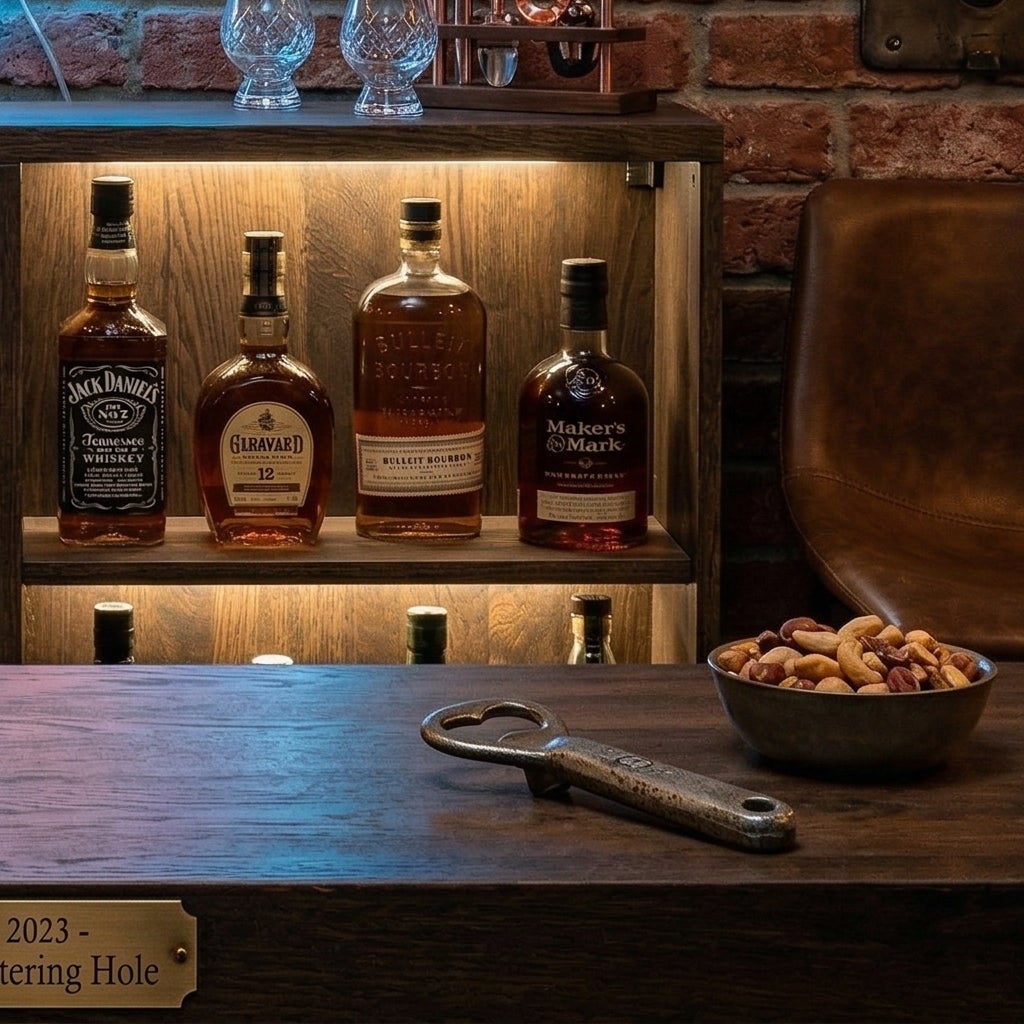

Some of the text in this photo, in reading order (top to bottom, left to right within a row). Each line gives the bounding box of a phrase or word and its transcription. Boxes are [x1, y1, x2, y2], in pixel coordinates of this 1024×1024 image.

[68, 376, 105, 405] JACK
[546, 419, 626, 436] Maker's
[567, 437, 626, 453] Mark
[82, 454, 145, 464] WHISKEY
[257, 467, 275, 481] 12
[5, 916, 70, 944] 2023
[90, 954, 160, 986] Hole
